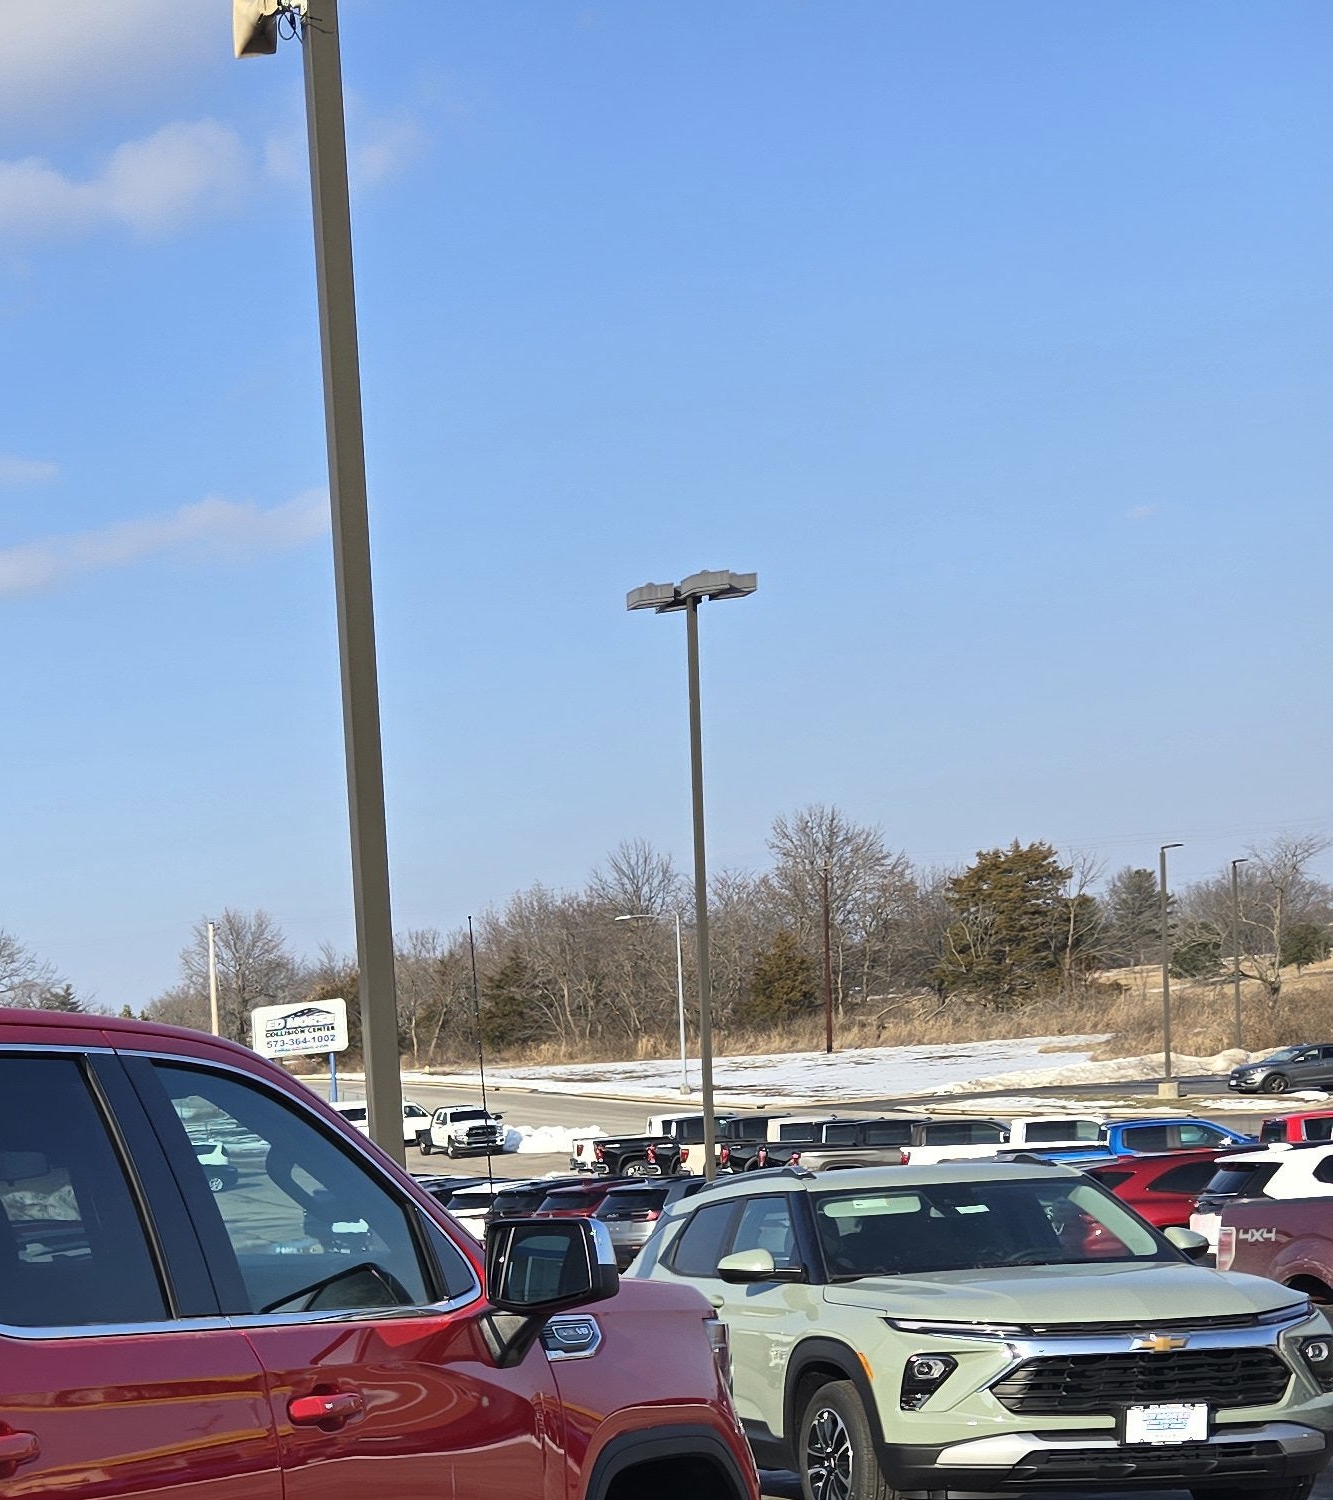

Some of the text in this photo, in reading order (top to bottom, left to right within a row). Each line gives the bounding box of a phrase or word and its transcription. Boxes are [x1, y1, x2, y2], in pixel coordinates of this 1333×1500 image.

[265, 1025, 335, 1038] COLLISION CENTER
[266, 1034, 336, 1049] 573-364-1002
